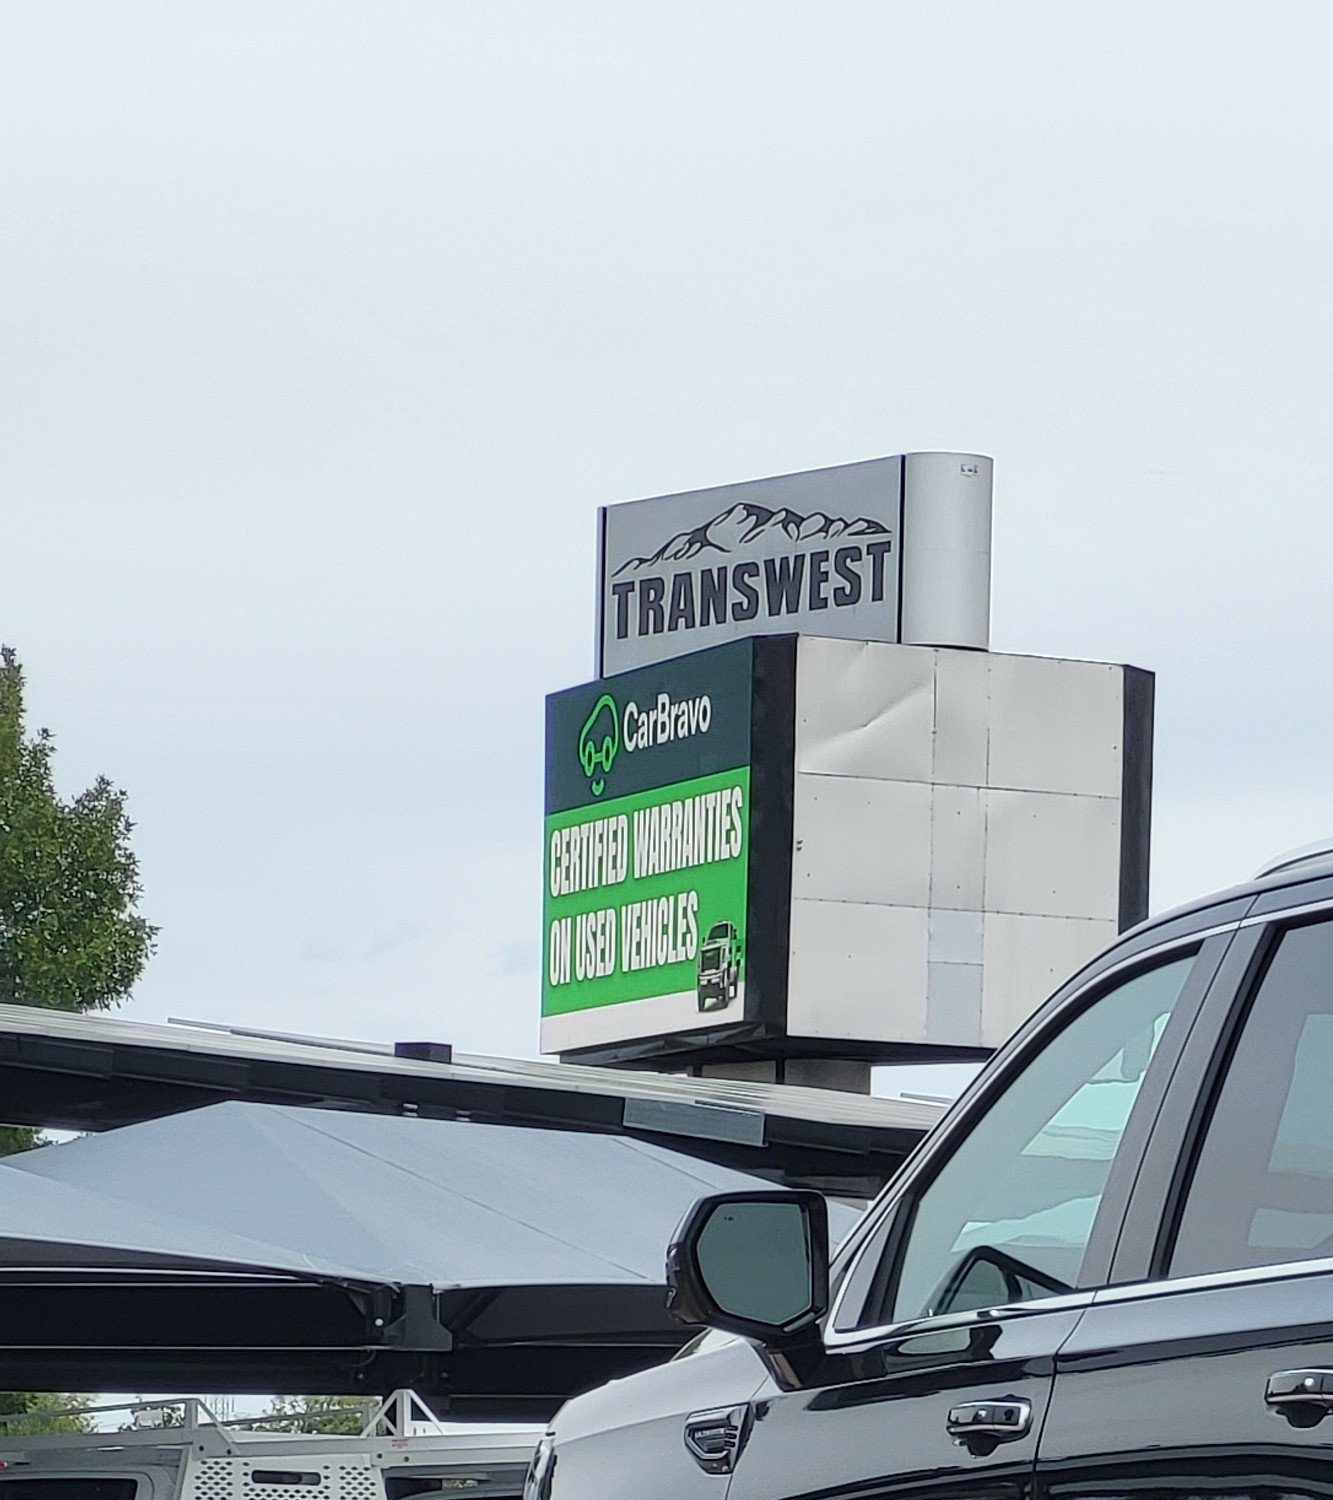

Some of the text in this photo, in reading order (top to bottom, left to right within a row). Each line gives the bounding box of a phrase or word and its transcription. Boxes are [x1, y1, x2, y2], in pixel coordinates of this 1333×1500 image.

[611, 541, 892, 638] TRANSWEST
[623, 694, 711, 752] CarBravo
[550, 786, 742, 898] CERTIFIED WARRANTIES
[549, 890, 698, 988] ON USED VEHICLES
